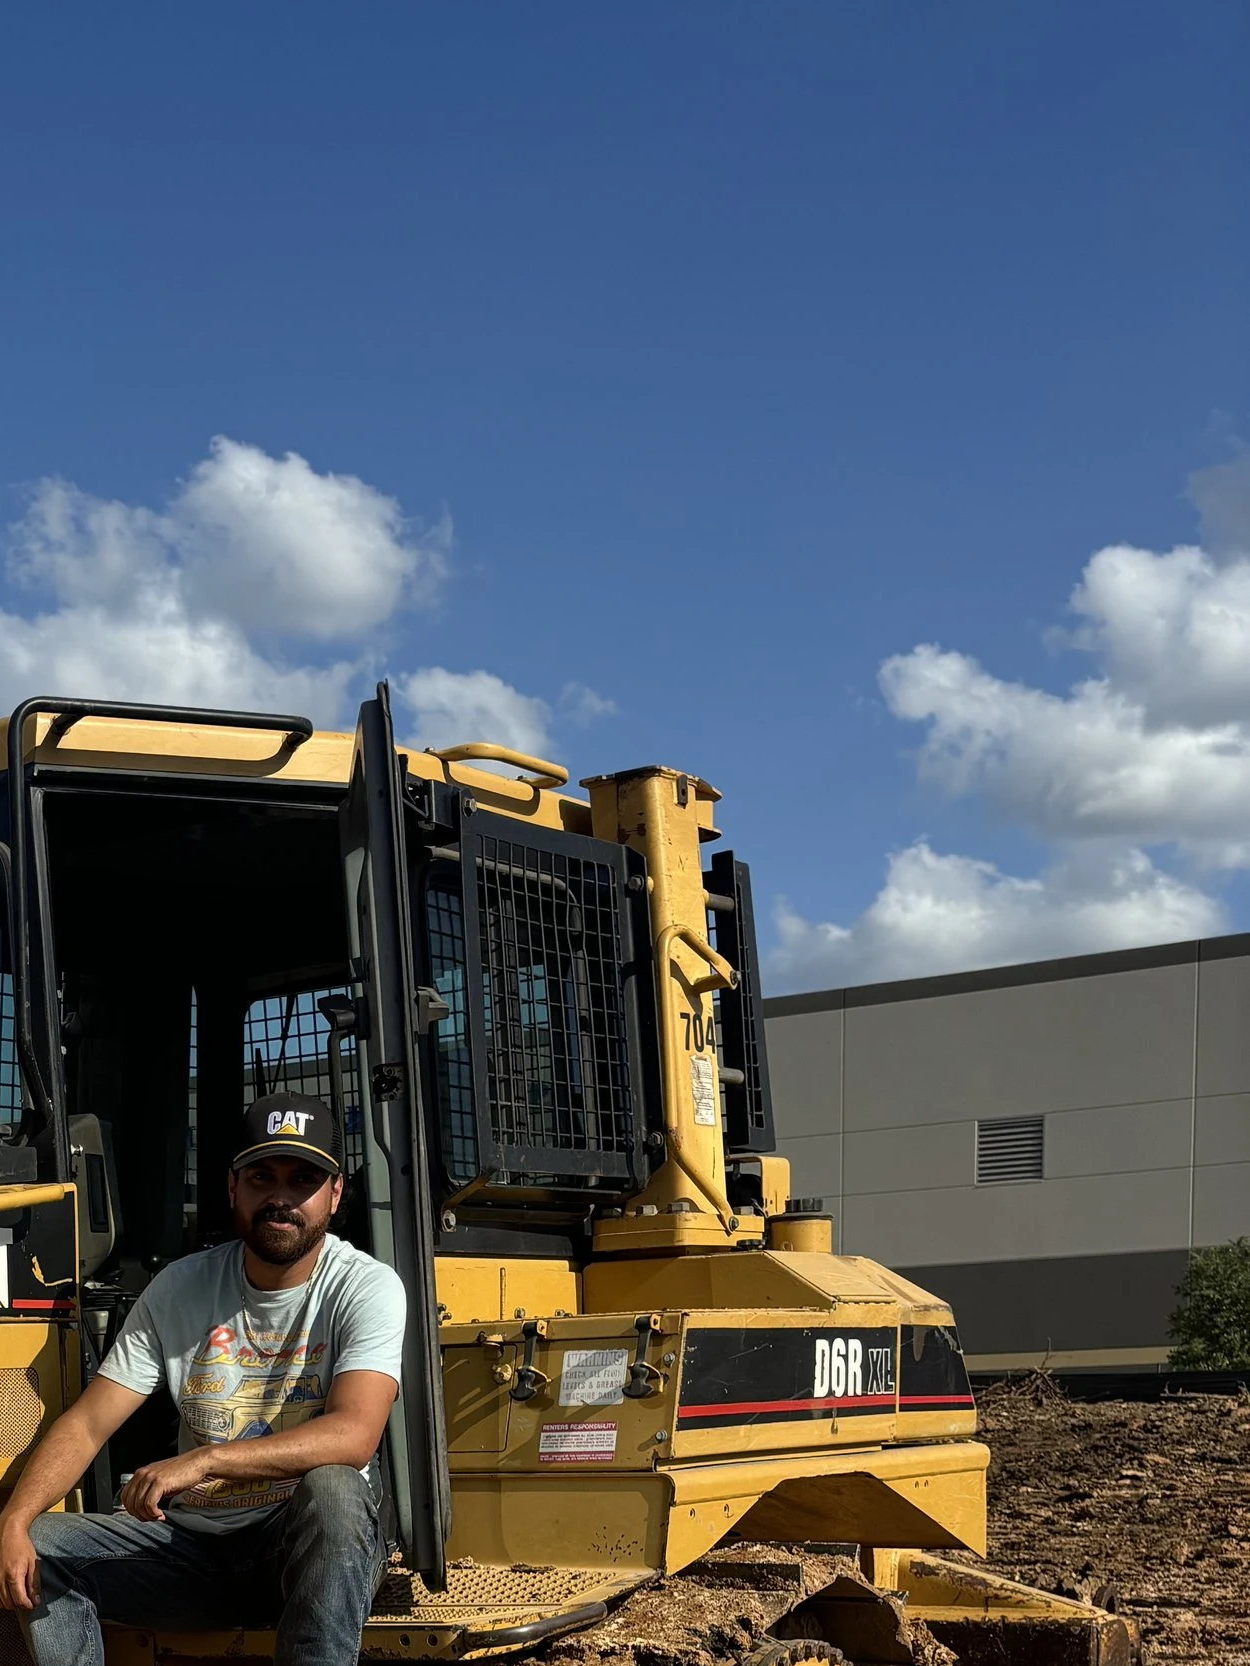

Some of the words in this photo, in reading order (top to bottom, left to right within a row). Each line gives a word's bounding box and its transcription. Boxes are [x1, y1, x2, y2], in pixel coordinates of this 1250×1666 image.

[680, 1012, 715, 1054] 704
[267, 1111, 307, 1136] CAT
[567, 1351, 624, 1367] WARNING
[813, 1338, 863, 1398] D6R
[867, 1348, 895, 1394] XL
[182, 1372, 226, 1396] Ford
[596, 1380, 623, 1389] GREASE
